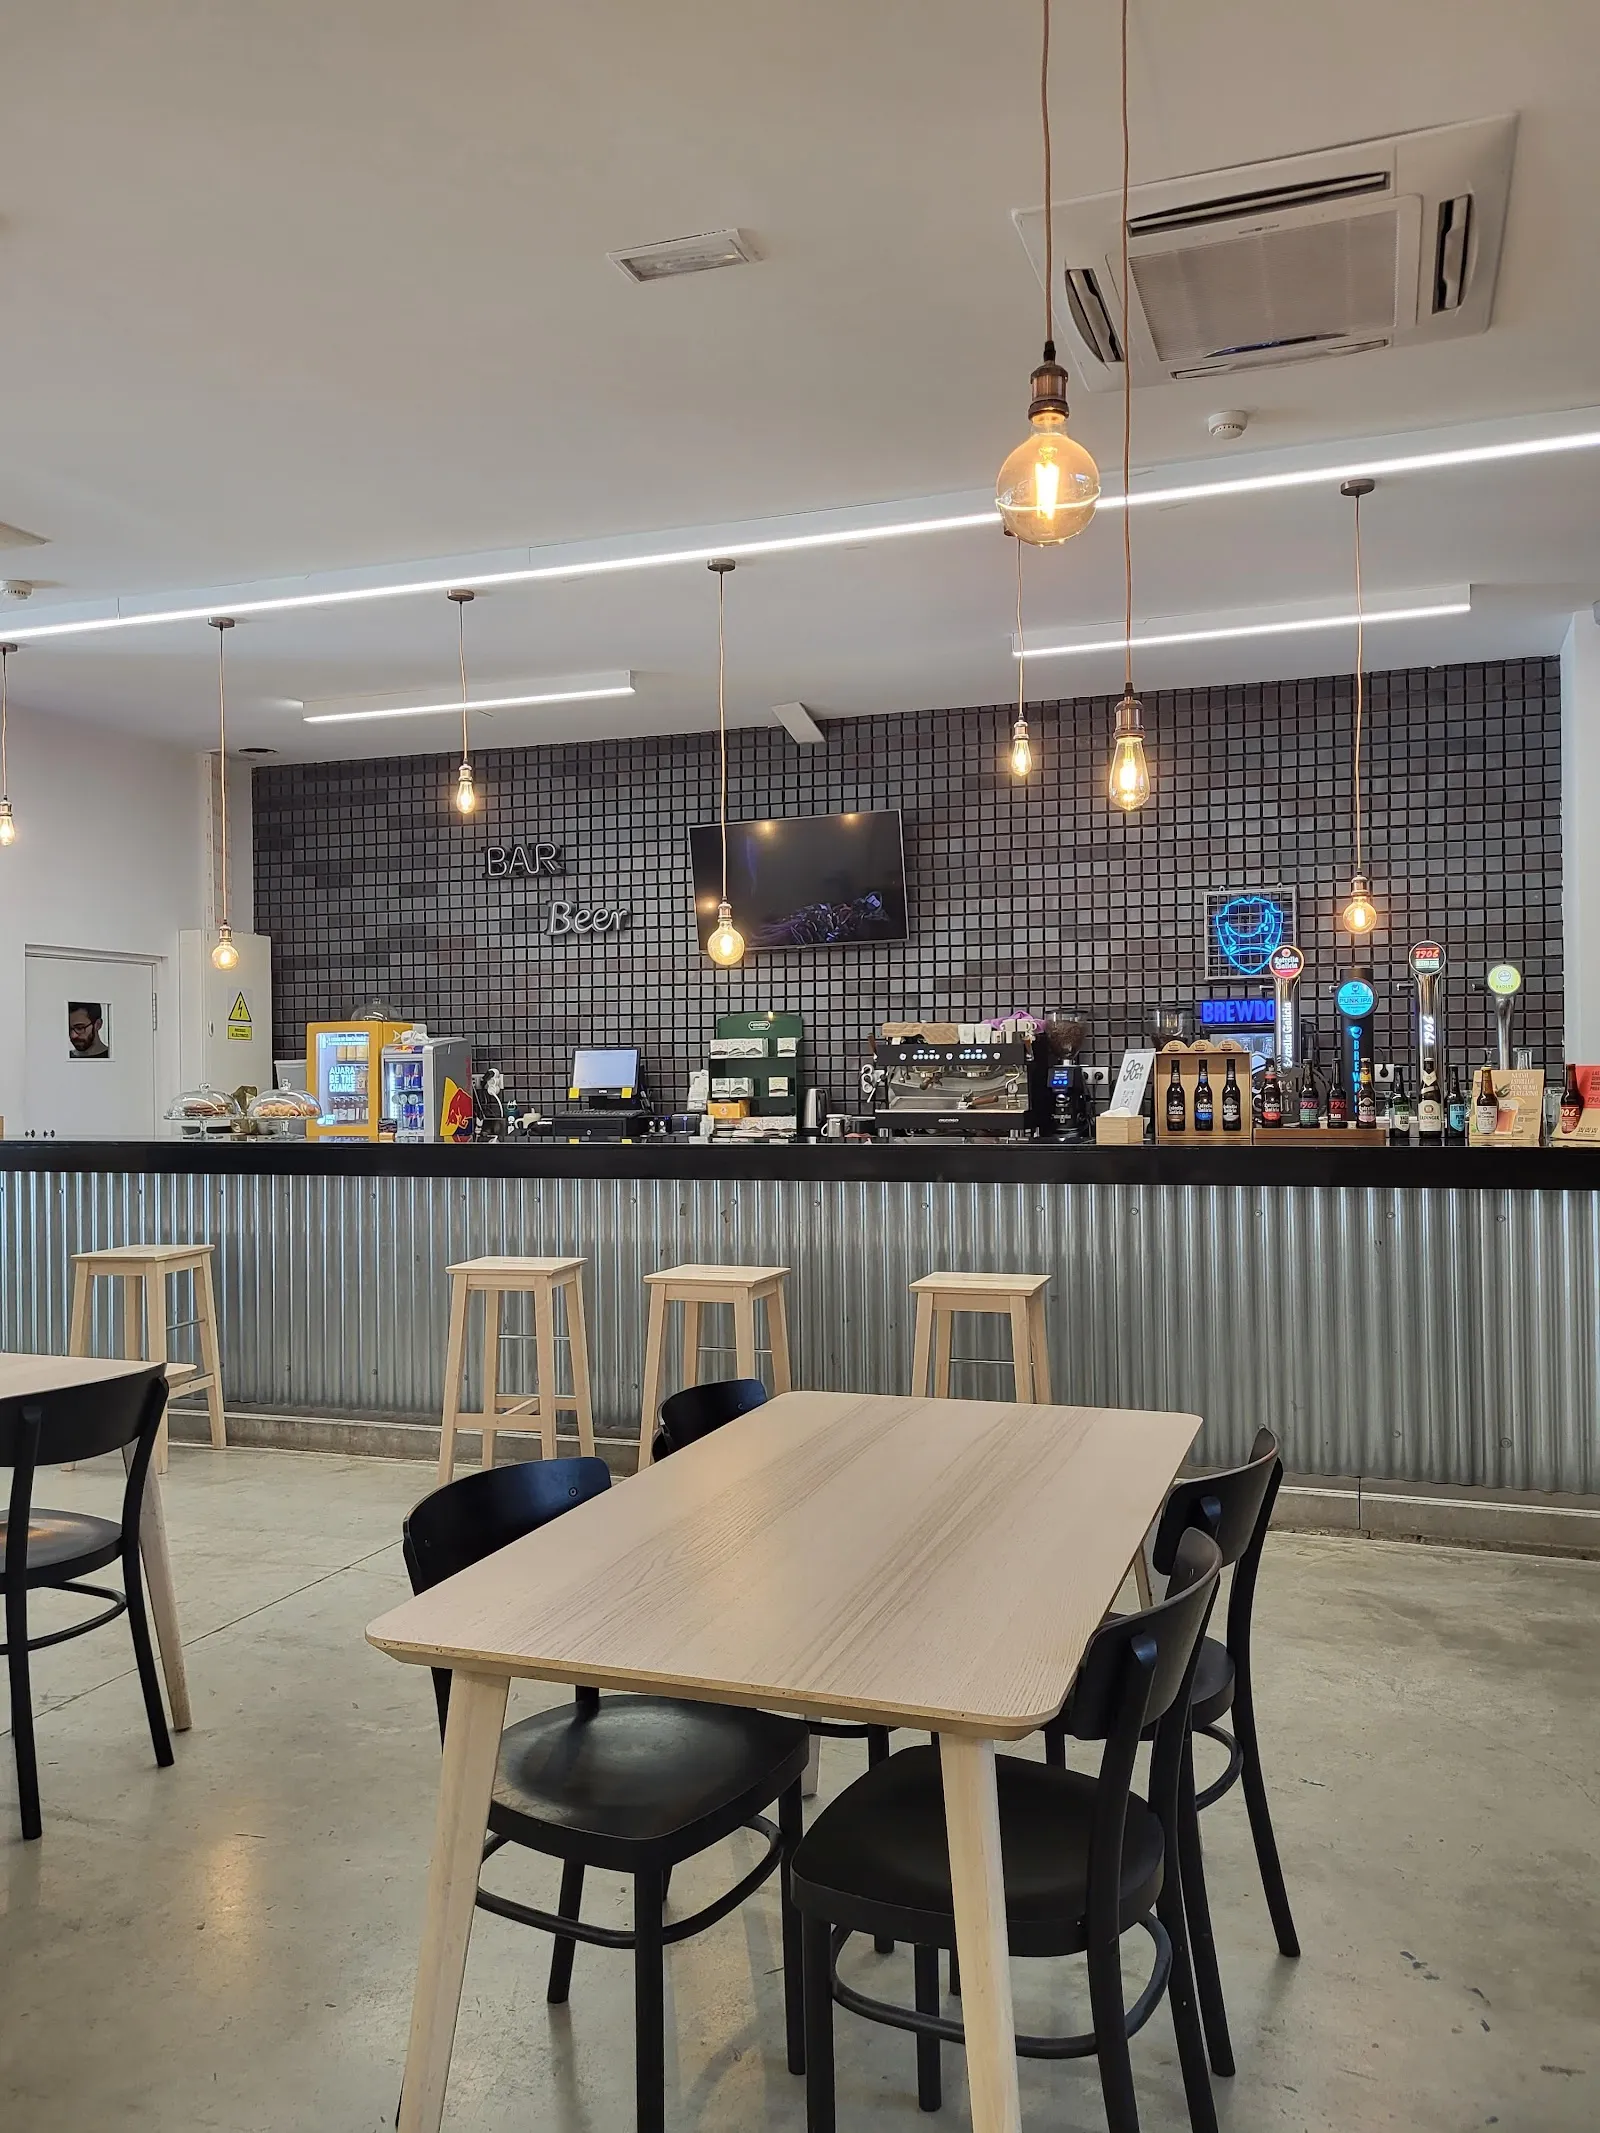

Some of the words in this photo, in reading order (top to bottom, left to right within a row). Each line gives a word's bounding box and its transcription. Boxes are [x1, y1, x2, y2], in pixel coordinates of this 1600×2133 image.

[485, 843, 561, 877] BAR
[549, 901, 629, 934] Beer
[1274, 956, 1299, 964] Estrella
[1415, 950, 1440, 959] 1906
[1202, 1000, 1275, 1023] BREWDO
[1282, 1002, 1292, 1033] Galicia
[1422, 1015, 1436, 1045] 1906
[1282, 1034, 1292, 1068] Erella
[329, 1075, 339, 1084] BE
[341, 1075, 355, 1084] THE
[329, 1083, 356, 1092] CHANGE
[1352, 1040, 1360, 1113] BREWD
